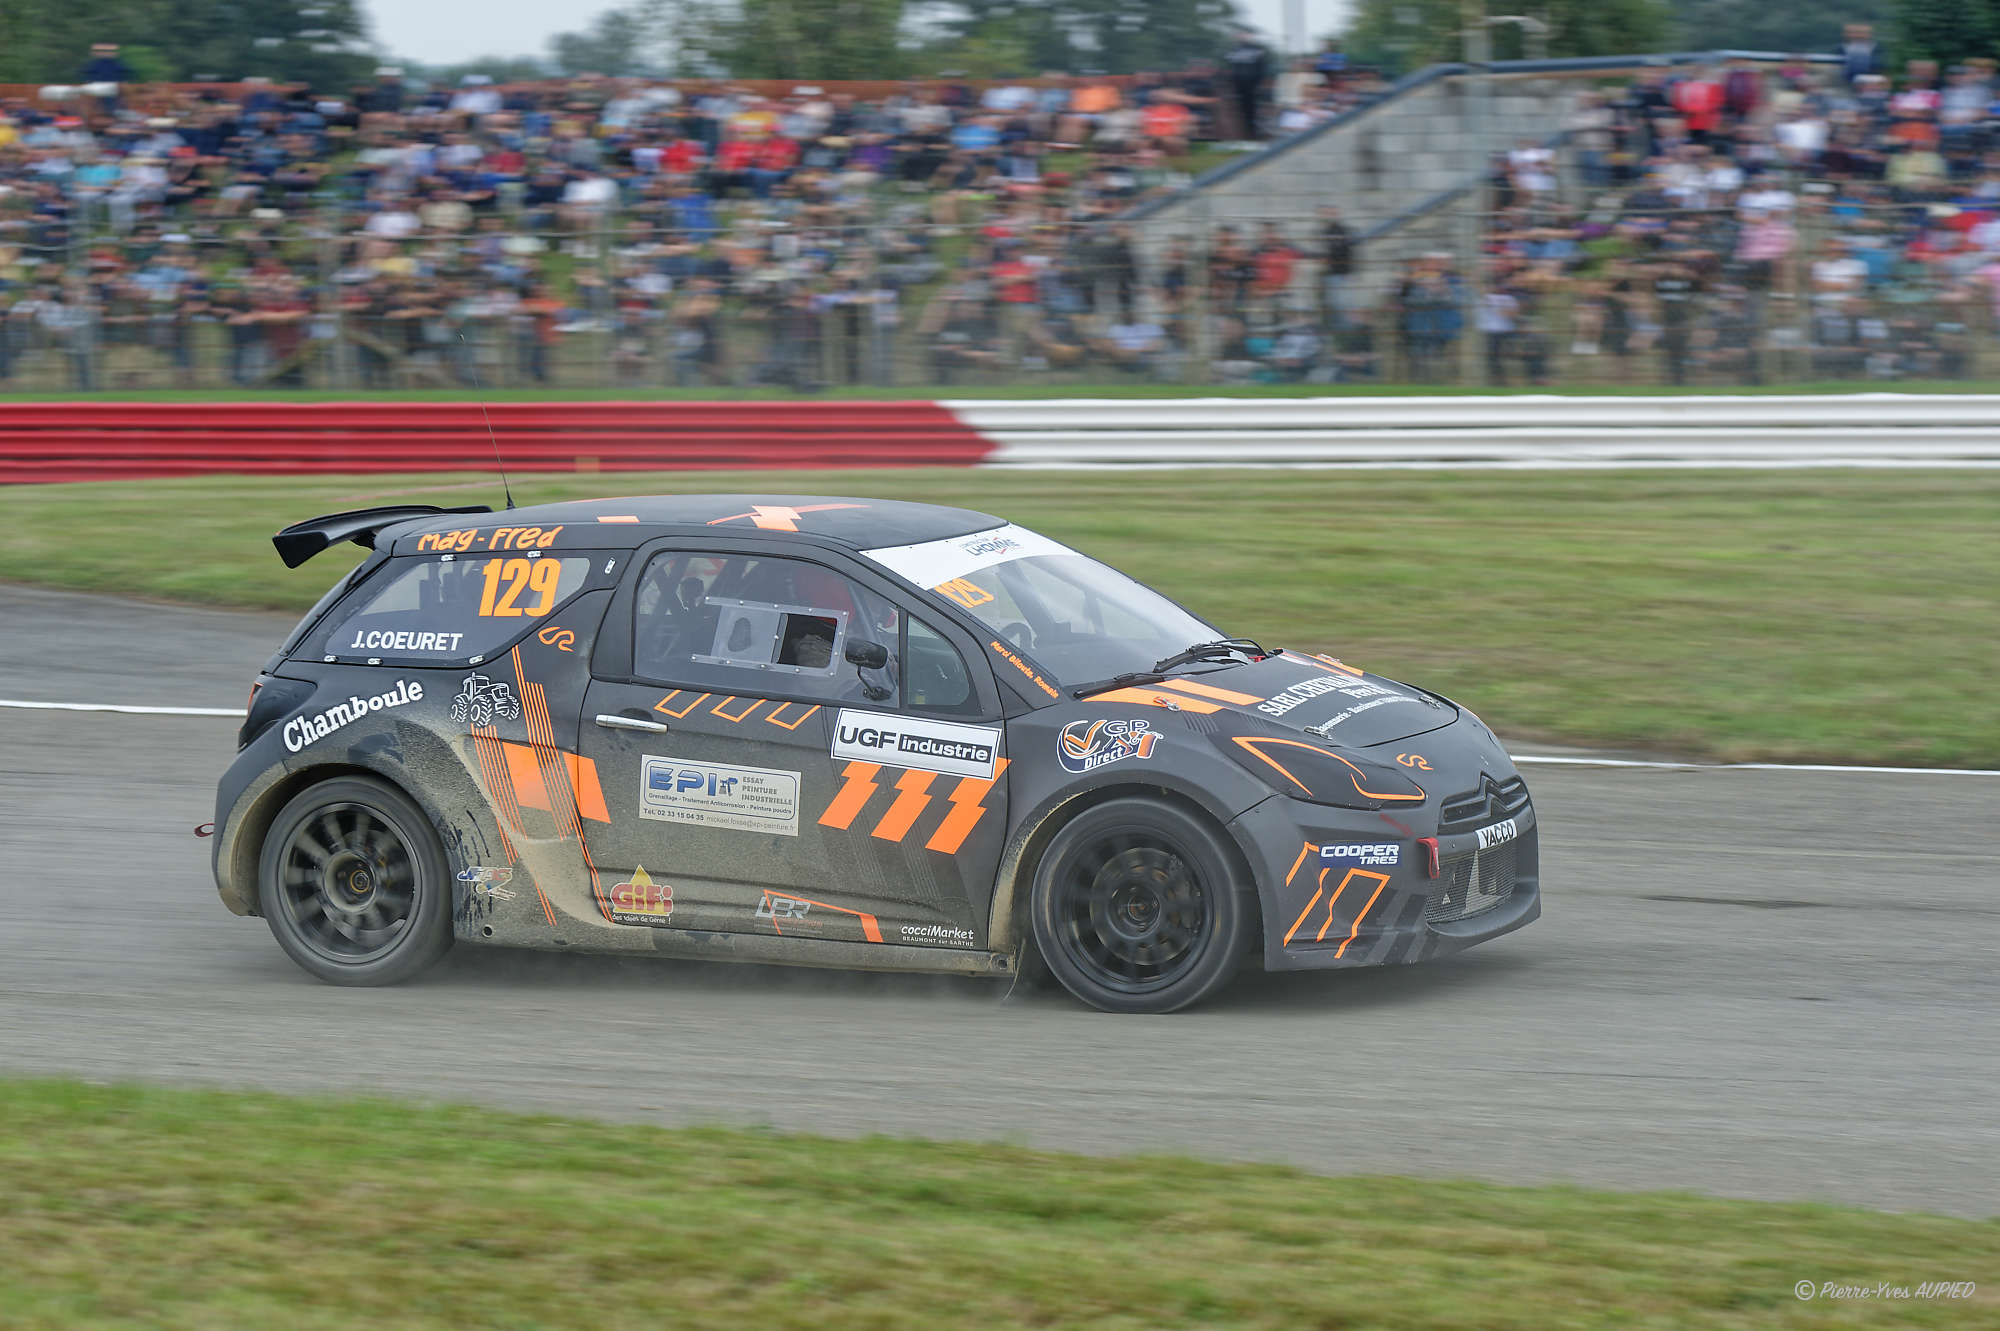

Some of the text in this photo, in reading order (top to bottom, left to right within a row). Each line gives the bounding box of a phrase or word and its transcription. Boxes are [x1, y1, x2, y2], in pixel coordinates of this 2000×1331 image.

[478, 558, 562, 617] 129
[933, 576, 995, 609] 129
[351, 630, 463, 651] J.COEURET
[1257, 692, 1309, 717] SARL
[283, 679, 424, 753] Chamboule
[839, 725, 989, 761] UGF industrie
[1084, 747, 1123, 769] Direct
[649, 766, 717, 797] EPI
[742, 777, 765, 785] ESSAY
[742, 786, 778, 795] PEINTURE
[741, 794, 792, 806] INDUSTRIELLE
[1482, 821, 1515, 847] YACCO
[1320, 844, 1399, 858] COOPER
[1359, 856, 1398, 865] TIRES
[901, 925, 974, 940] cocciMarket
[902, 936, 936, 944] BEAUMONT
